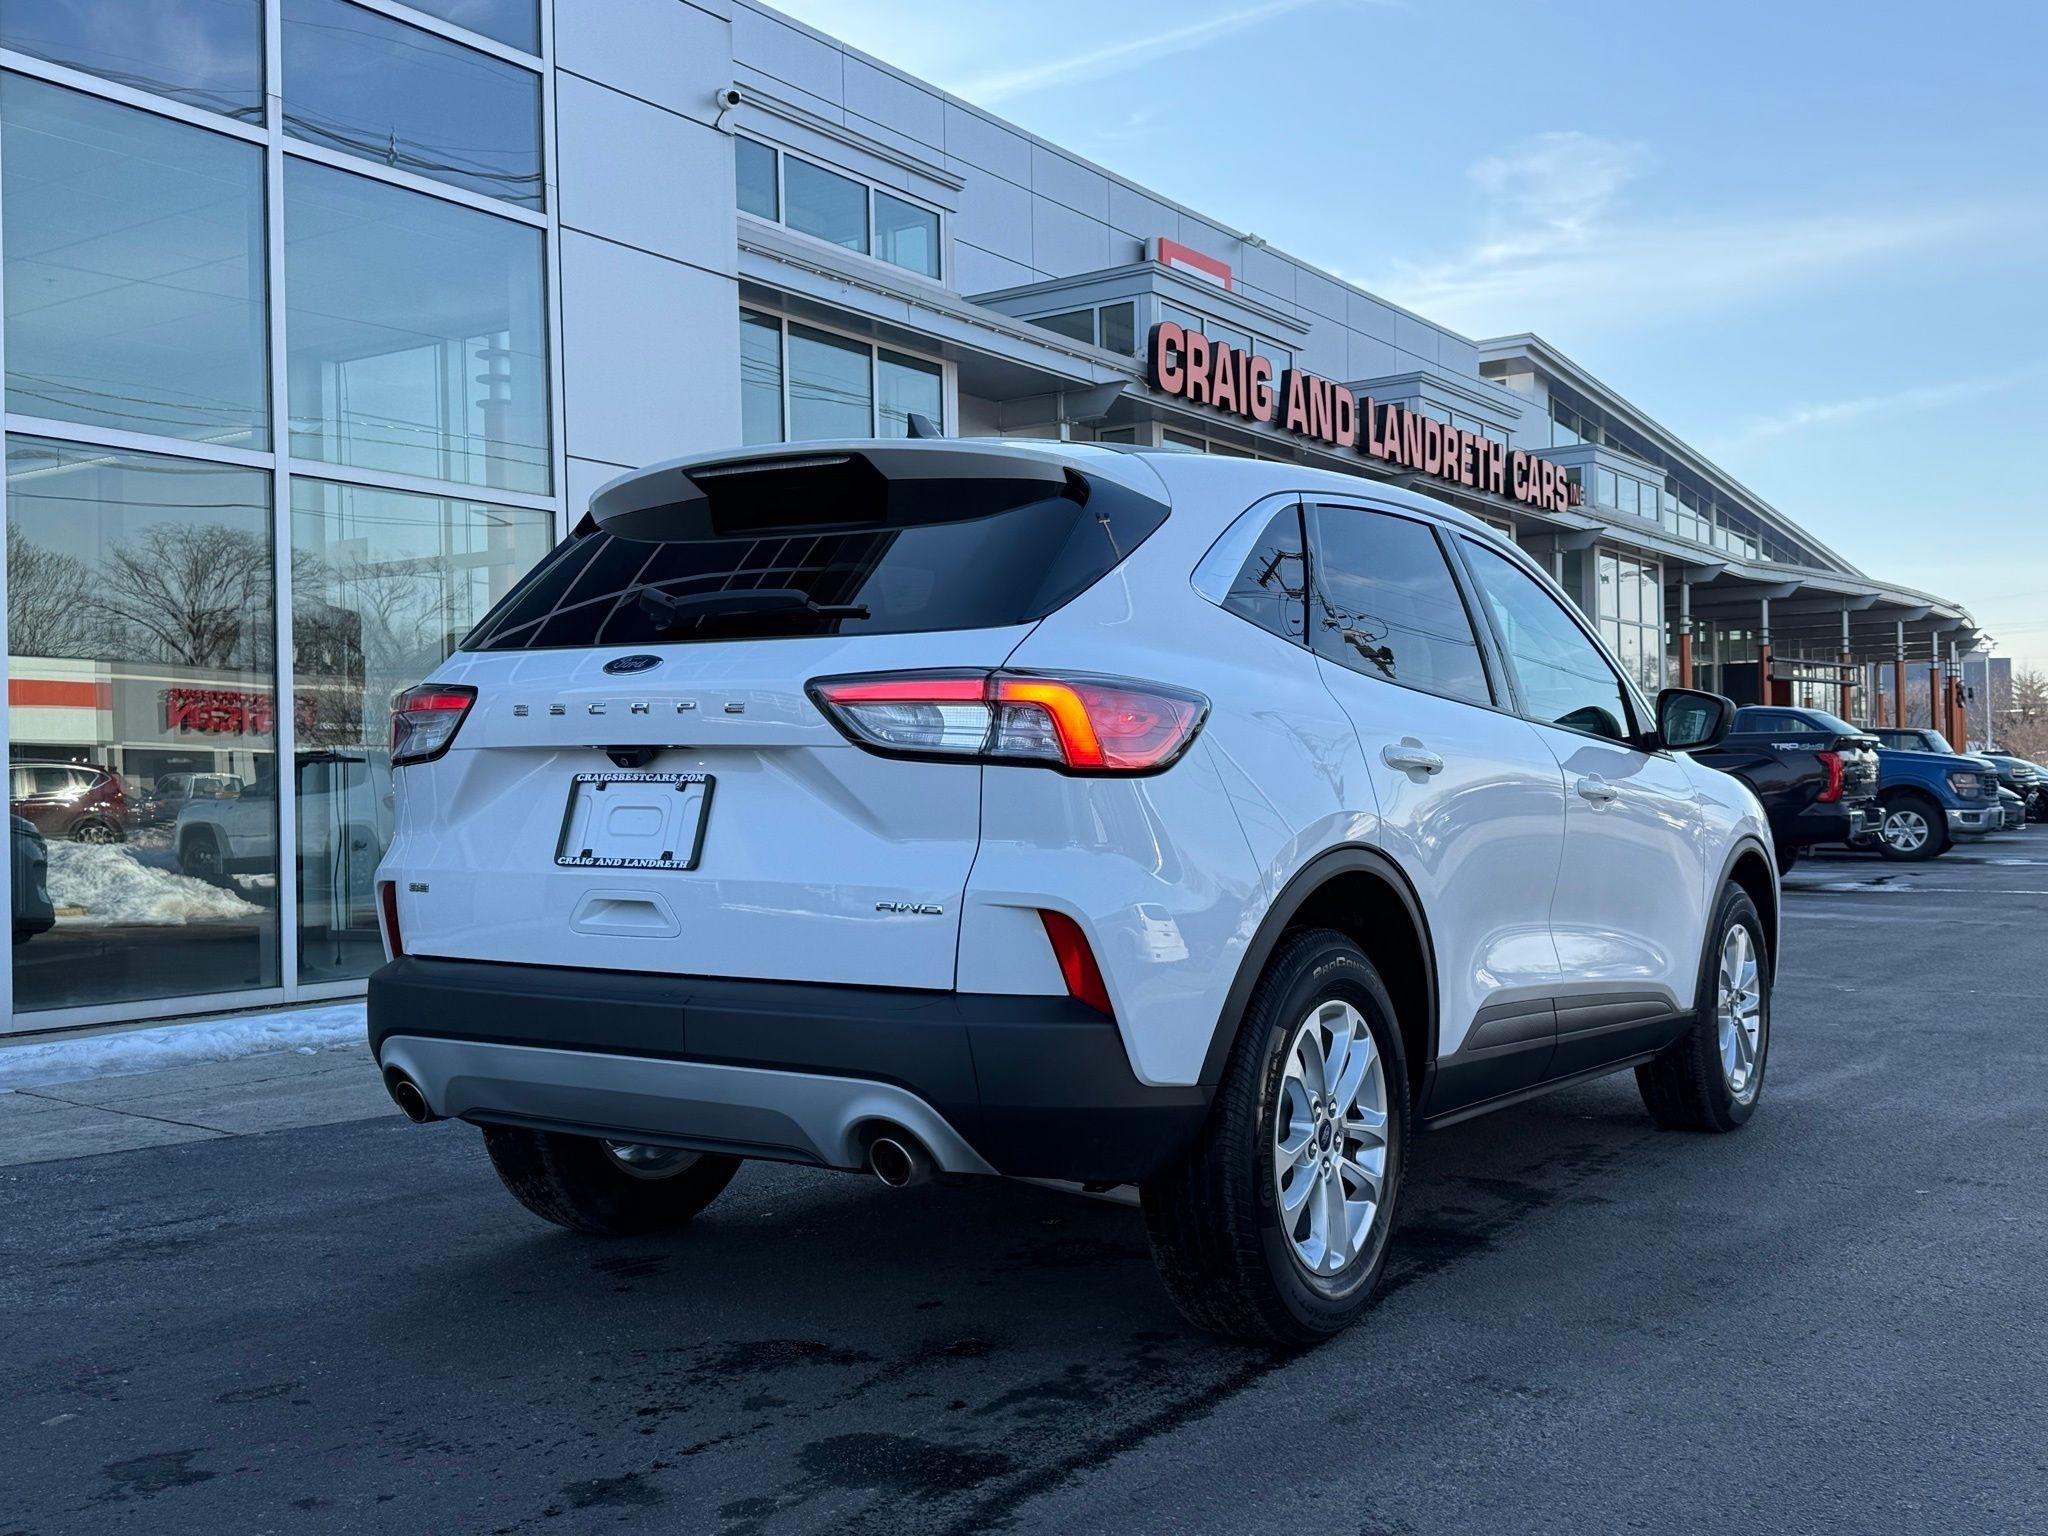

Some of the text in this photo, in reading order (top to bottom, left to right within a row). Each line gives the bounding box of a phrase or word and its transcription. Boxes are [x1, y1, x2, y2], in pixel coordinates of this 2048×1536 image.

[1153, 321, 1273, 423] CRAIG
[1285, 368, 1356, 448] AND
[1365, 396, 1505, 495] LANDRETH
[1510, 450, 1569, 513] CARS
[512, 701, 746, 717] ESCAPE
[1771, 742, 1799, 751] TRD
[576, 773, 706, 782] CRAIGSBESTCARS.COM
[557, 857, 689, 869] CRAIG AND LANDRETH
[872, 899, 927, 910] AWD
